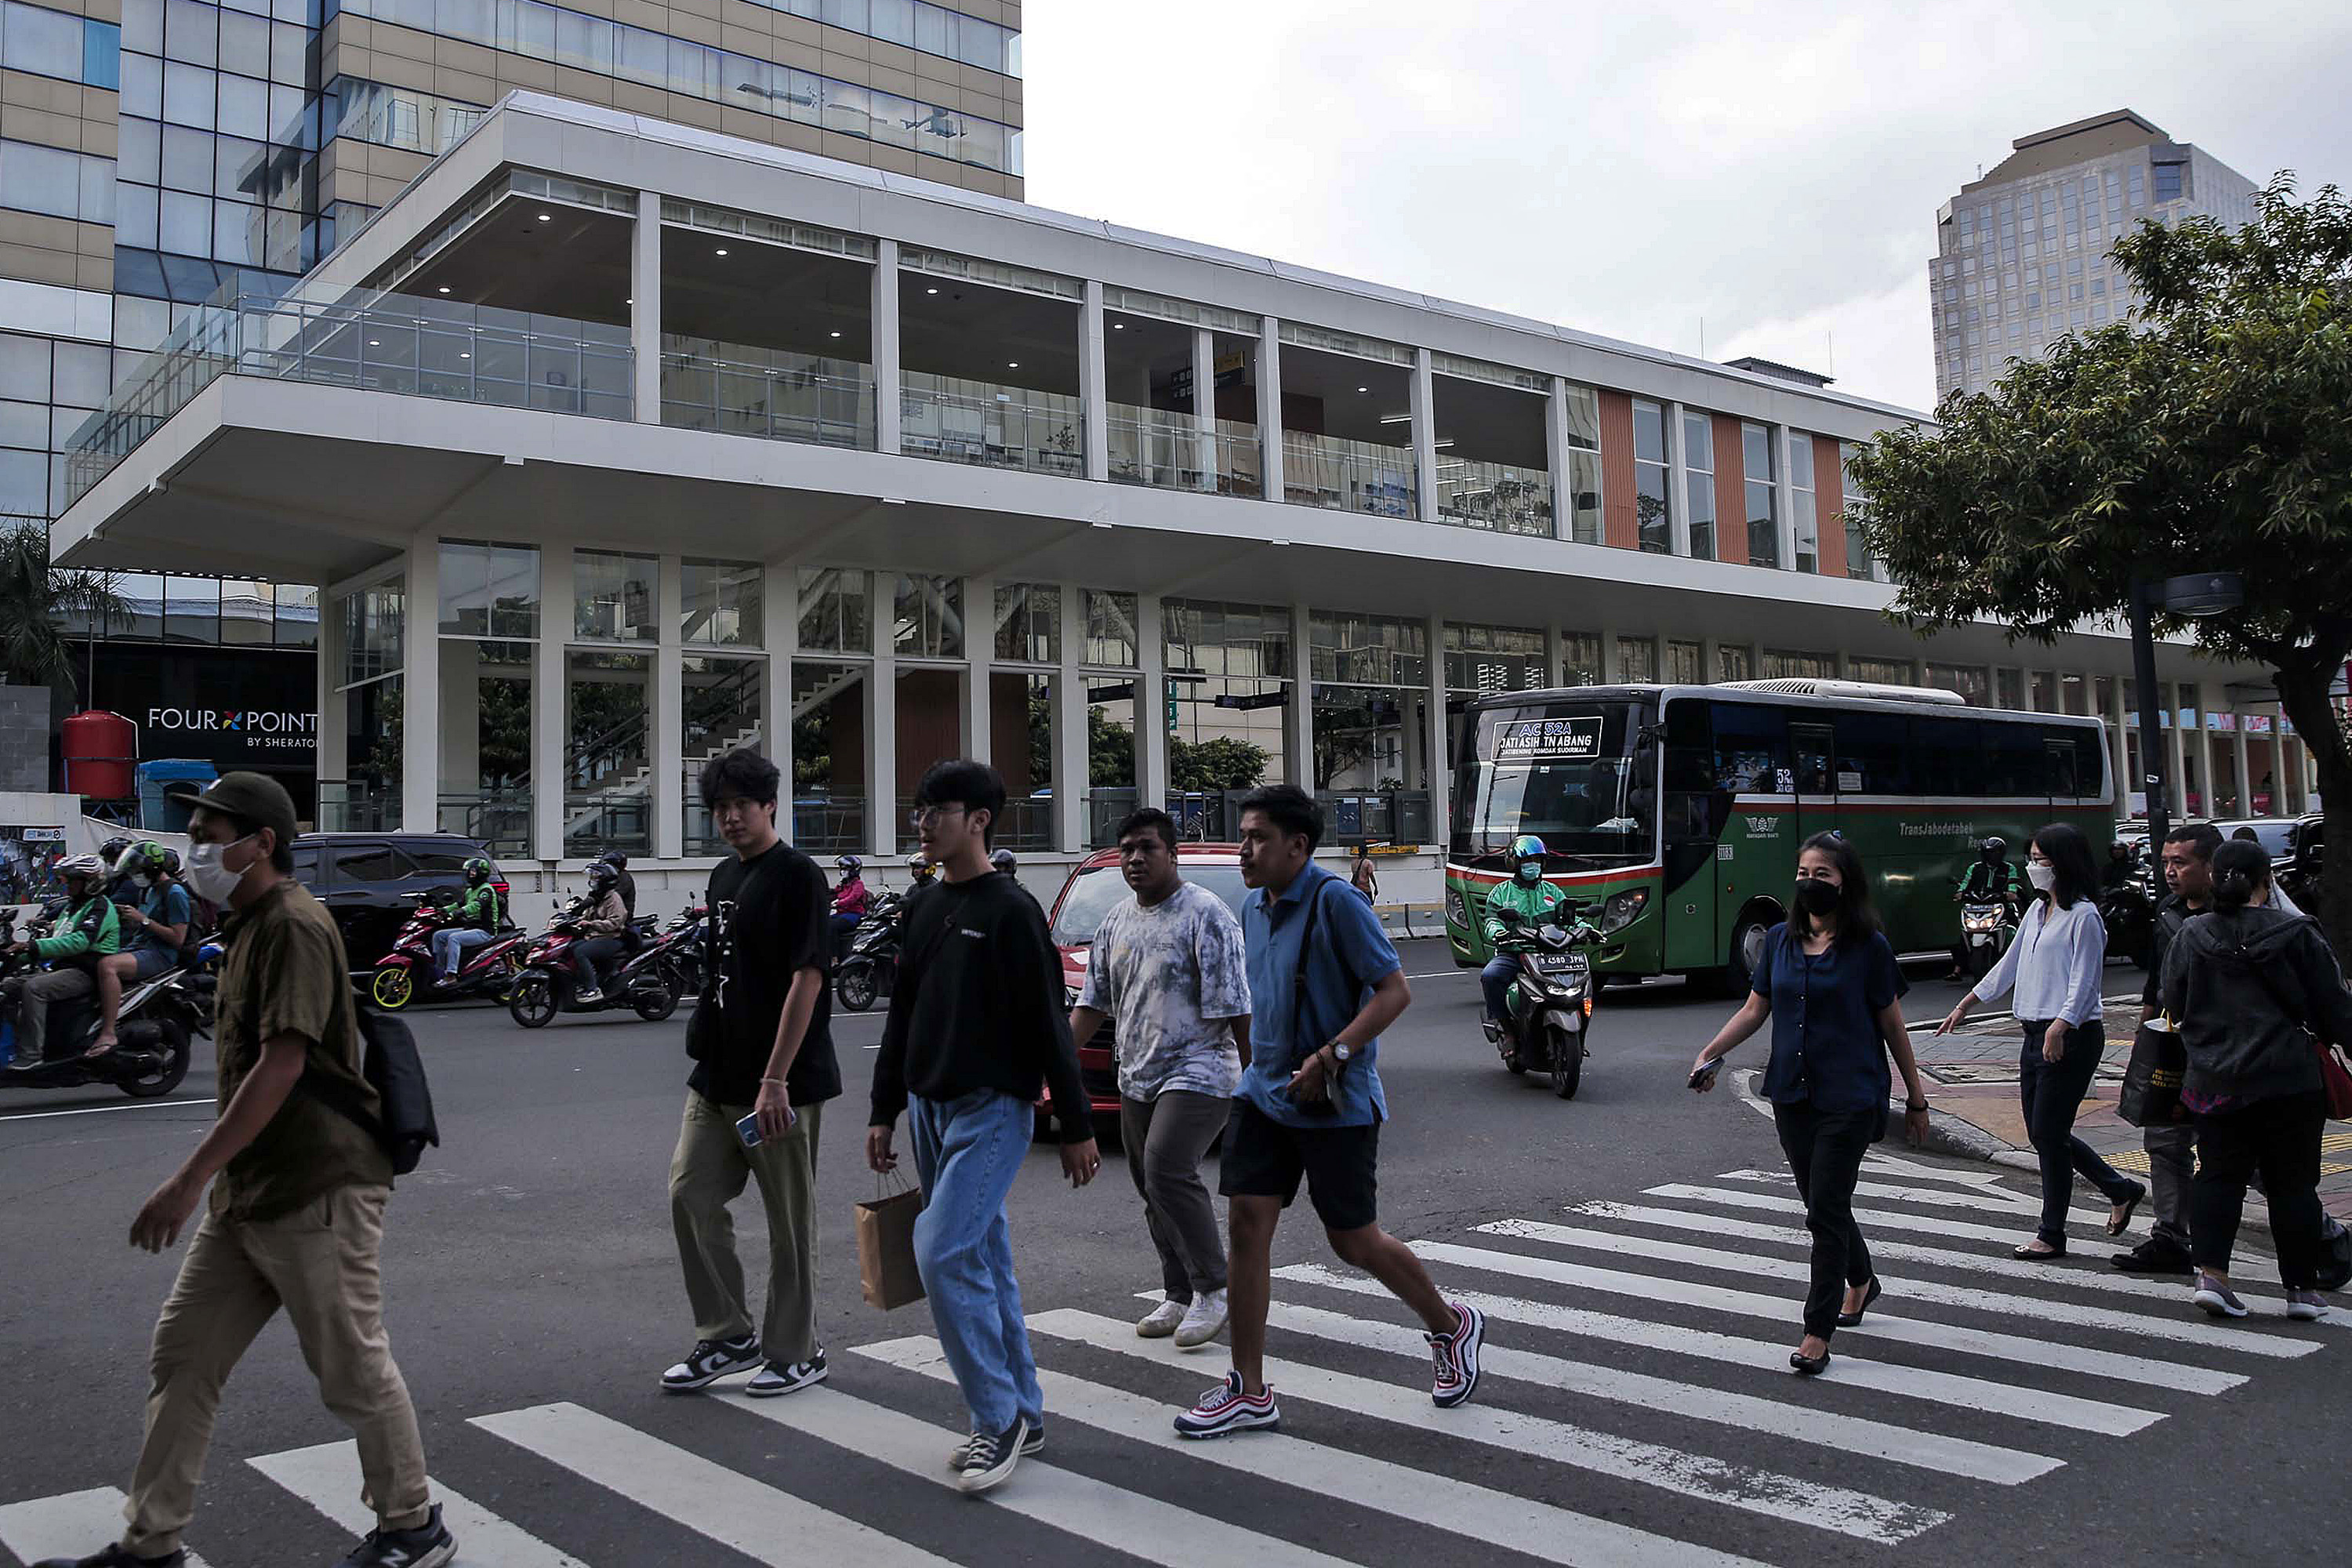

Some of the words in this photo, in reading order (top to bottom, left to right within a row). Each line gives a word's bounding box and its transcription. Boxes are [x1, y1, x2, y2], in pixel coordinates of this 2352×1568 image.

[148, 708, 219, 730] FOUR
[1519, 724, 1541, 737] AC
[1544, 722, 1572, 736] 52A
[248, 738, 261, 746] BY
[265, 738, 318, 748] SHERATO
[1557, 735, 1592, 746] ABANG
